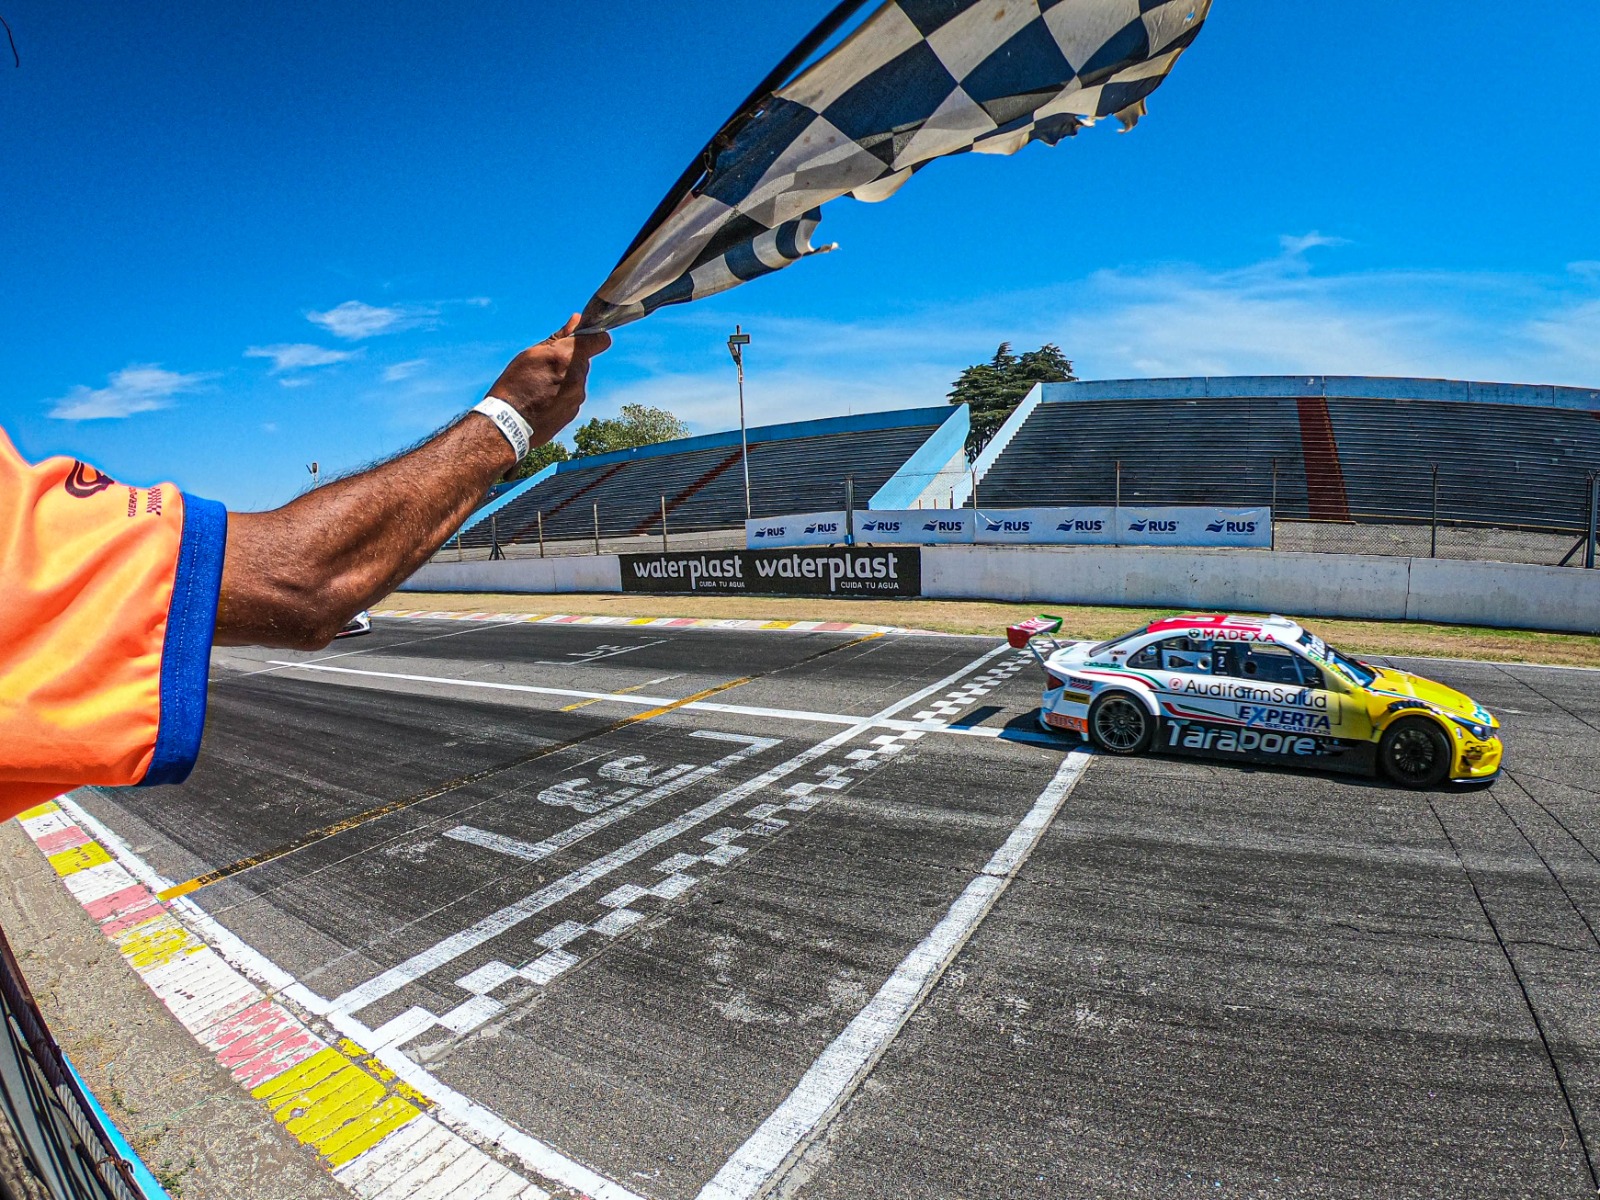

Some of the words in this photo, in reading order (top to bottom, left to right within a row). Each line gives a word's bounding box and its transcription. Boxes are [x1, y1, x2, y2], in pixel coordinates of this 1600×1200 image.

[817, 523, 838, 533] RUS
[877, 521, 901, 531] RUS
[938, 521, 963, 531] RUS
[1003, 521, 1031, 531] RUS
[1074, 520, 1103, 530] RUS
[1148, 520, 1177, 531] RUS
[1226, 521, 1255, 532] RUS
[767, 527, 786, 537] RUS
[633, 554, 743, 590] waterplast
[754, 552, 899, 592] waterplast
[699, 580, 717, 588] CUIDA
[840, 581, 863, 589] CUIDA
[877, 582, 900, 590] AGUA
[1202, 629, 1277, 643] MADEXA
[1218, 656, 1226, 667] 2
[1184, 679, 1327, 709] AudifarmSalud
[1239, 705, 1331, 730] EXPERTA
[1264, 722, 1332, 736] SEGUROS
